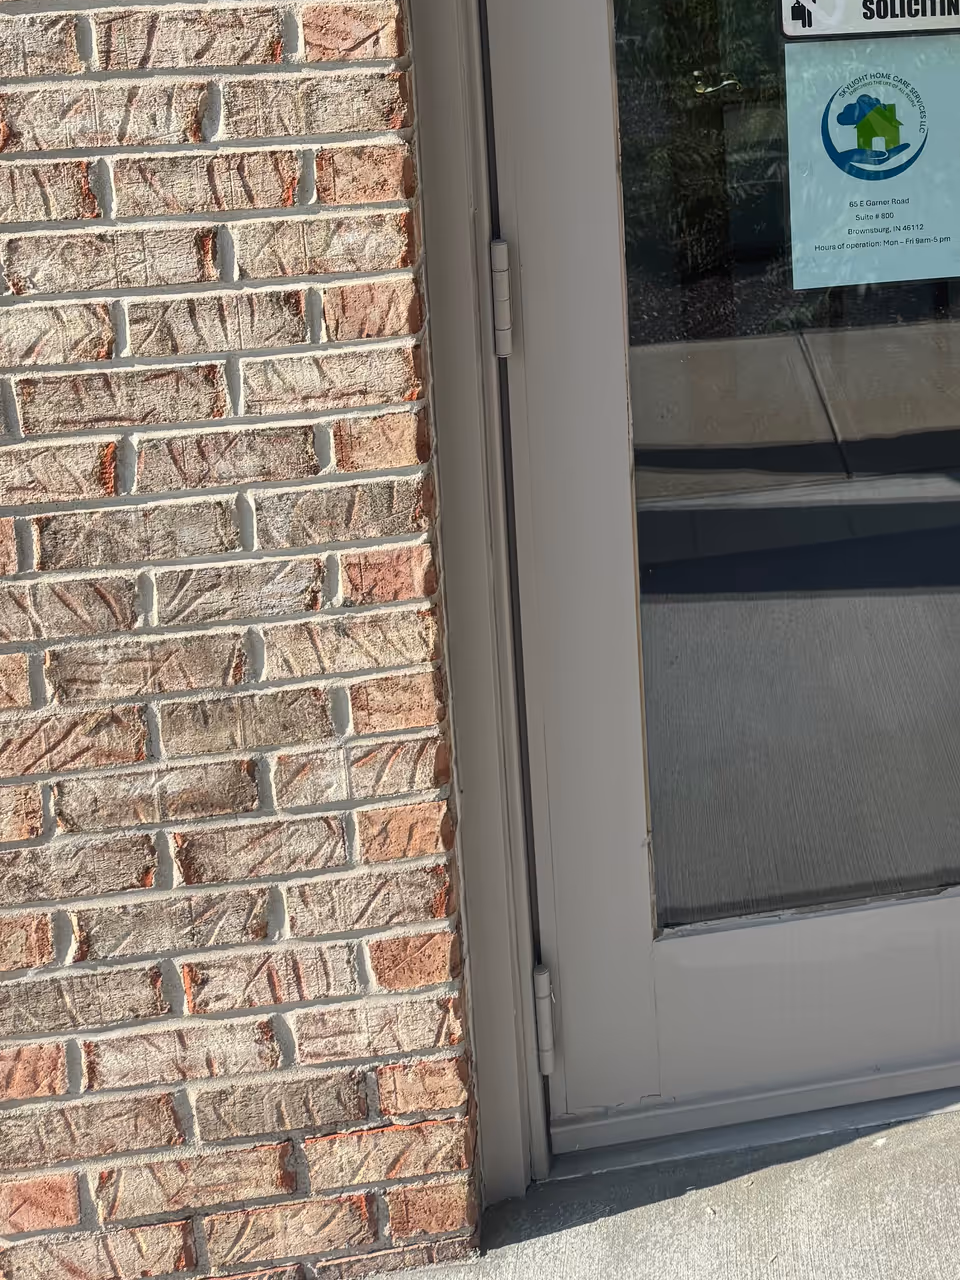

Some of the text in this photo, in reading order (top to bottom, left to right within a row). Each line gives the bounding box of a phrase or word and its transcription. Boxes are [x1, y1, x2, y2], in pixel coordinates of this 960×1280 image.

[838, 72, 927, 134] SKYLIGHT HOME CARE SERVICES LLC
[865, 199, 890, 207] Garner
[848, 226, 892, 235] Brownsburg,
[902, 223, 924, 231] 46112
[846, 240, 882, 250] operation:
[905, 237, 915, 245] Fri
[939, 236, 951, 244] pm
